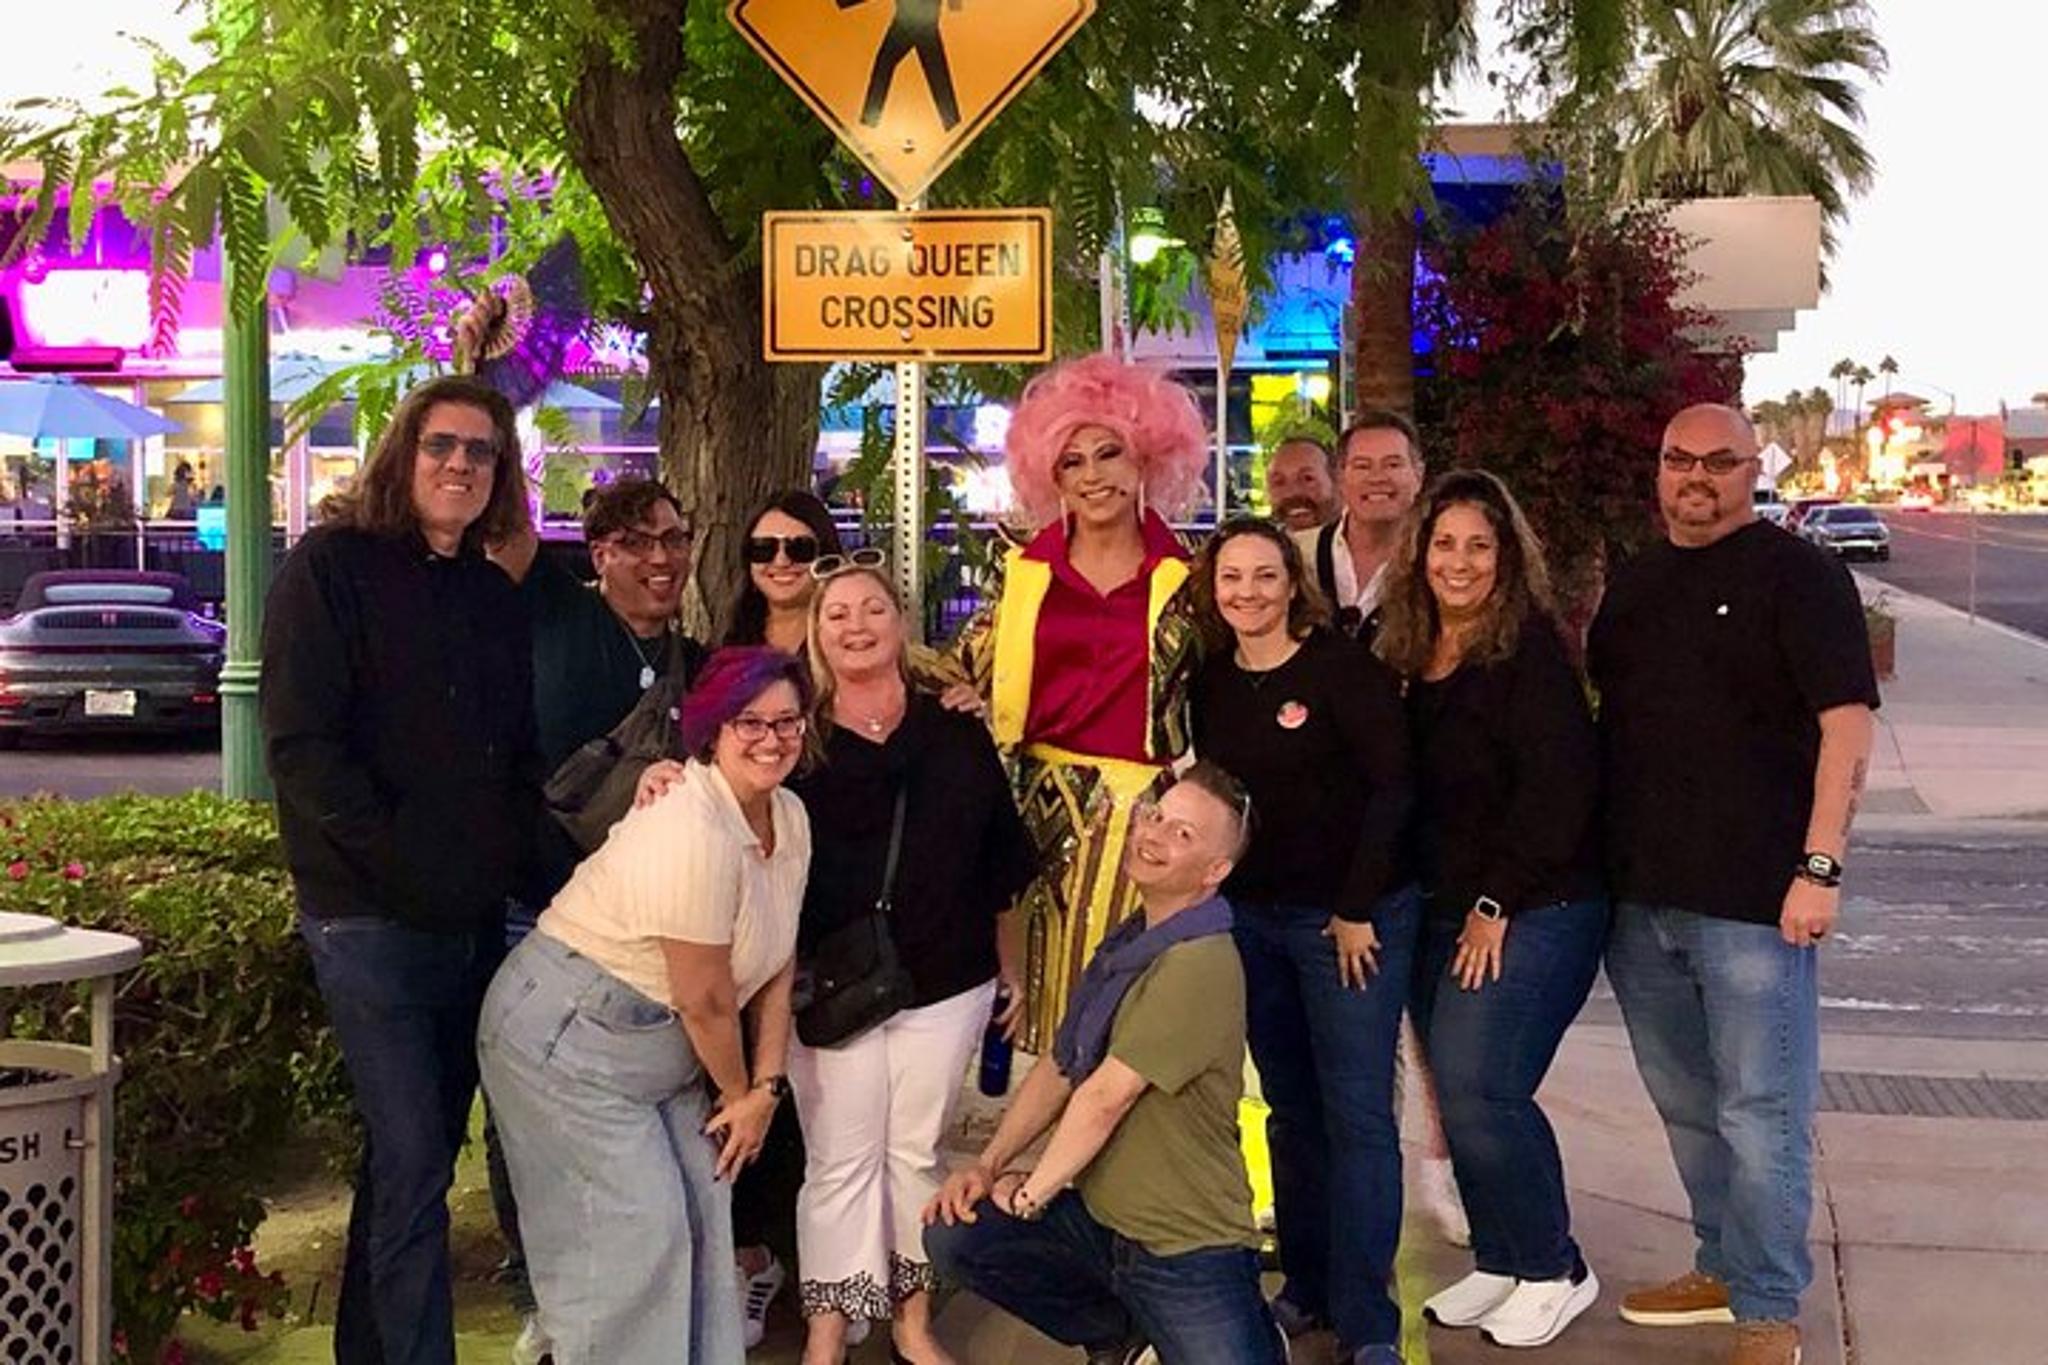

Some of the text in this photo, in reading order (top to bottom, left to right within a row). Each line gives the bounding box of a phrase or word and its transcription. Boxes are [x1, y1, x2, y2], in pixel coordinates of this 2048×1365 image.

[795, 243, 1020, 277] DRAG QUEEN
[821, 295, 994, 328] CROSSING
